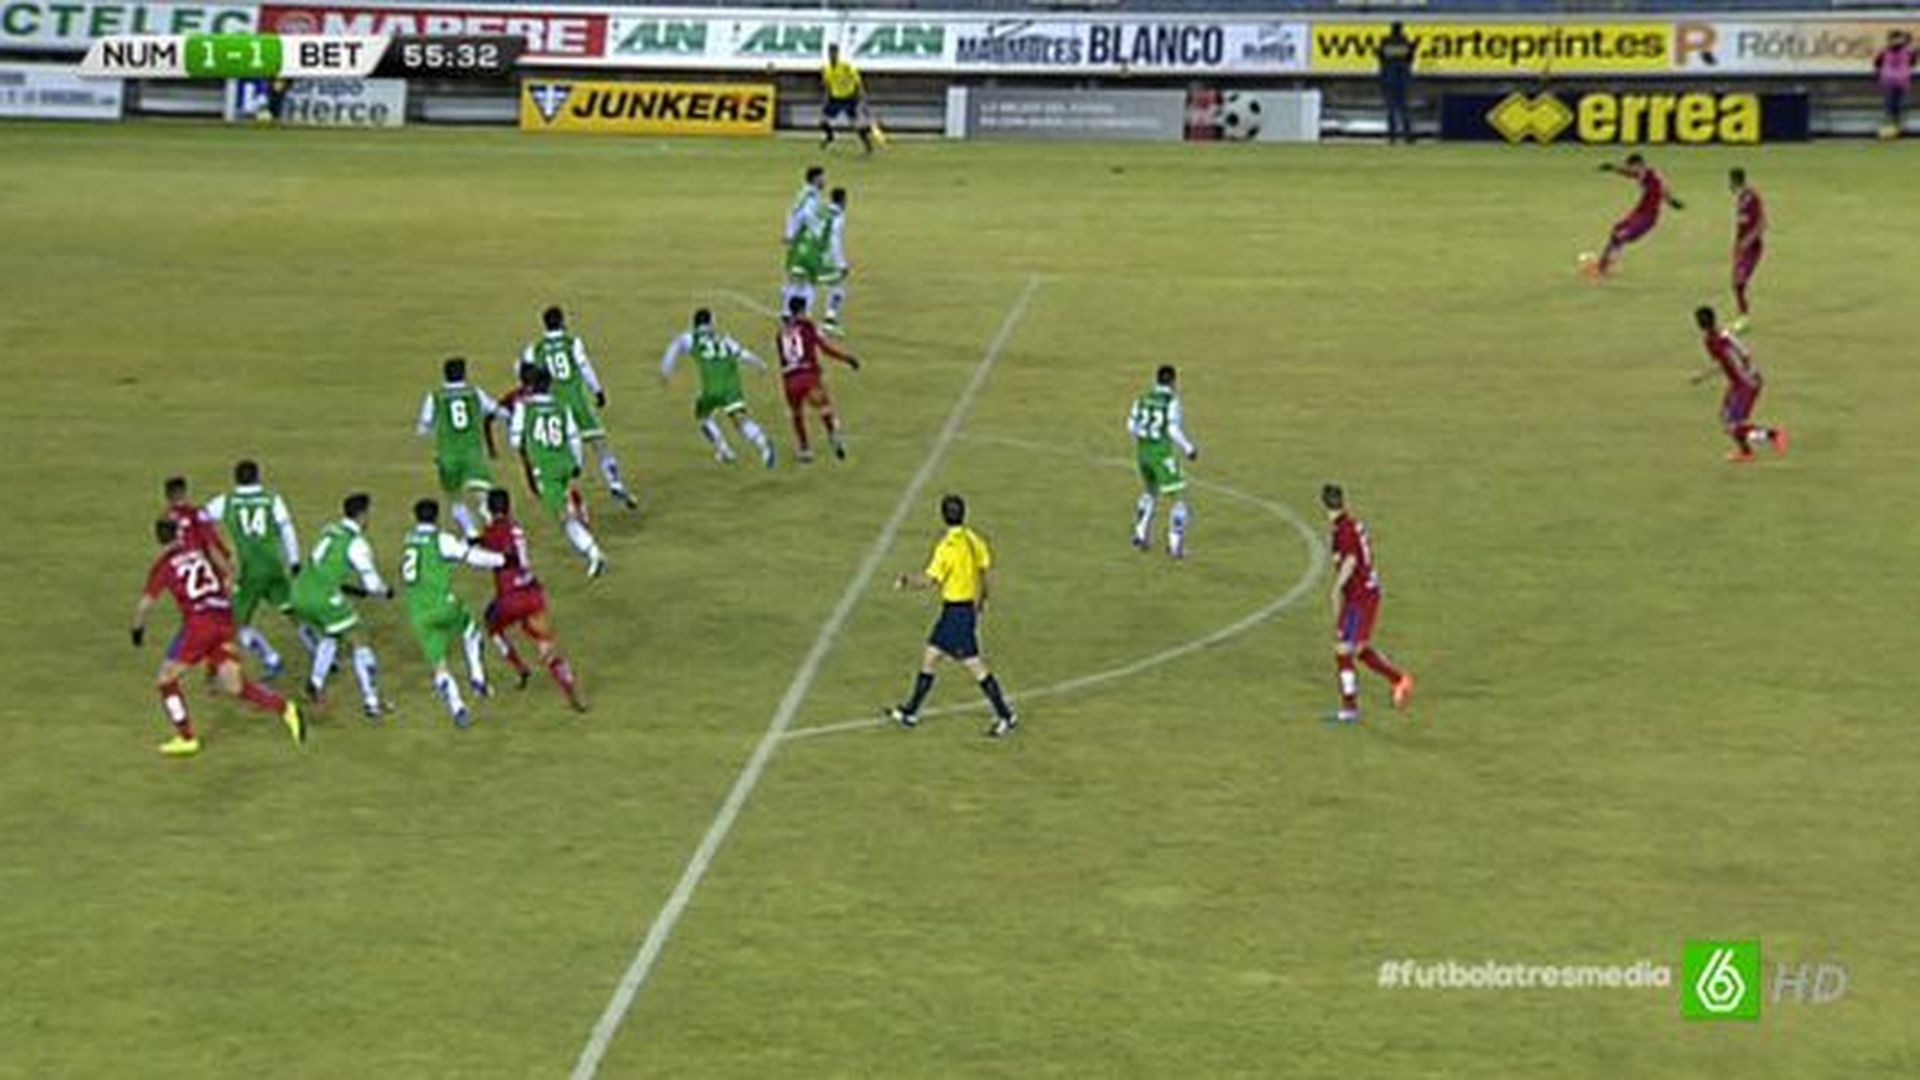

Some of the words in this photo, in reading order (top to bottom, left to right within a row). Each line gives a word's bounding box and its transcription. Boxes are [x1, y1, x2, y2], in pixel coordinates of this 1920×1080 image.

[1088, 24, 1224, 65] BLANCO
[571, 91, 767, 122] JUNKERS
[1577, 92, 1761, 142] errea
[546, 351, 571, 380] 19
[450, 399, 469, 429] 6
[533, 415, 563, 447] 46
[176, 555, 221, 600] 23
